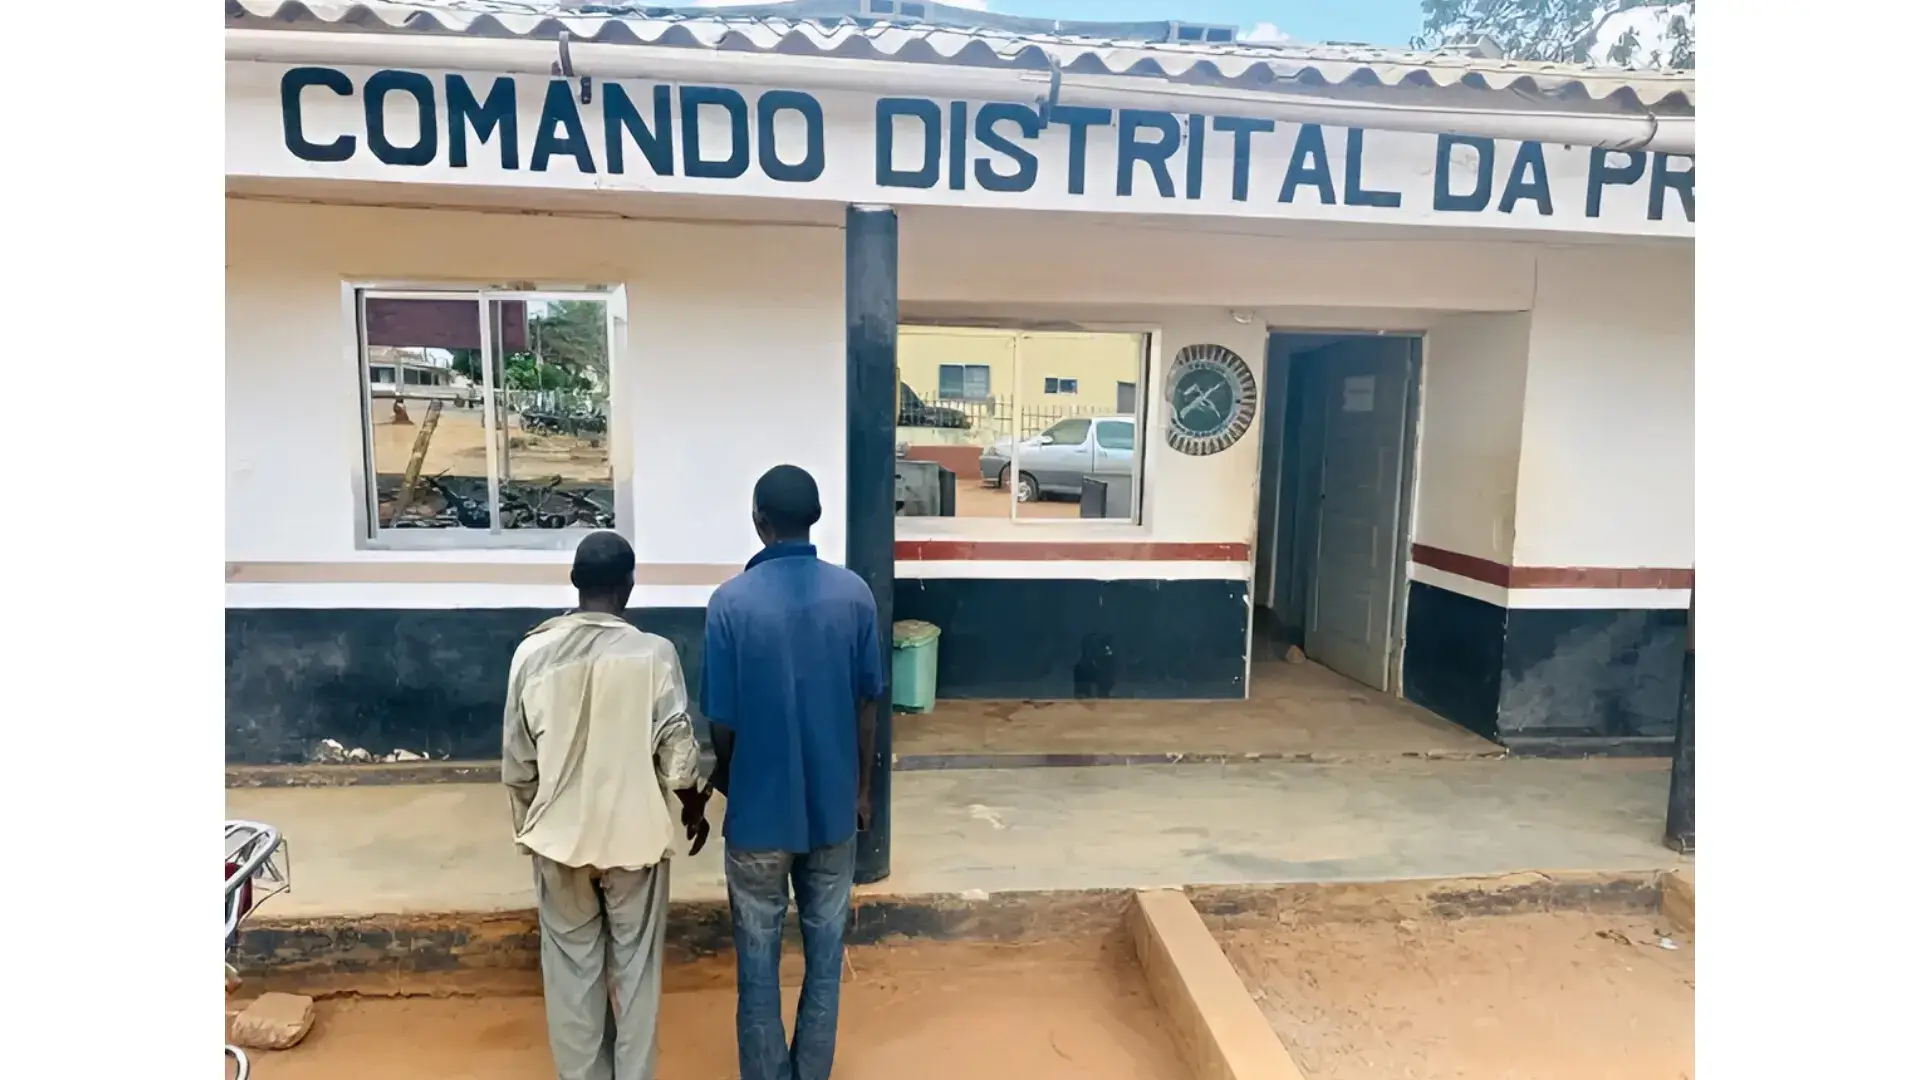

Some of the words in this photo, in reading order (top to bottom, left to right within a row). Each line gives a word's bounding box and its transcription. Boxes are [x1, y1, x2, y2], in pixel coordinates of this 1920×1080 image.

[281, 67, 825, 182] COMANDO
[876, 98, 1401, 207] DISTRITAL
[1434, 133, 1553, 215] DA
